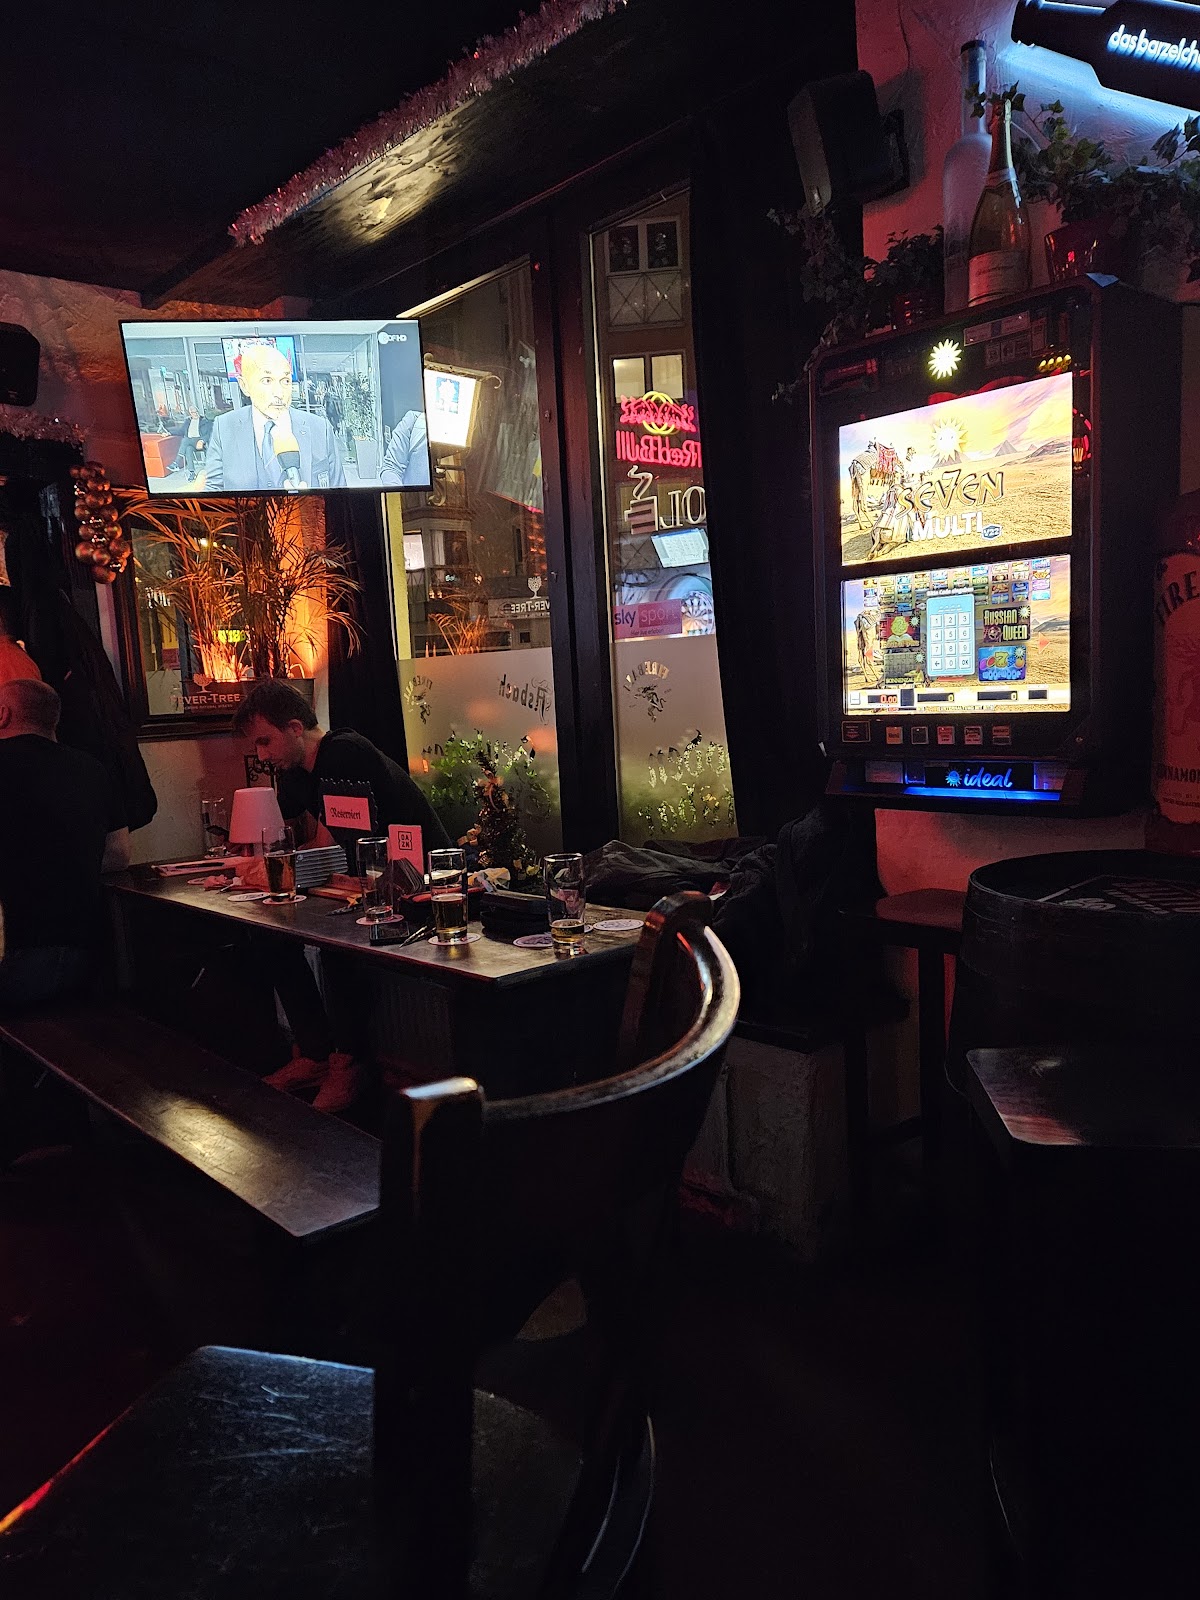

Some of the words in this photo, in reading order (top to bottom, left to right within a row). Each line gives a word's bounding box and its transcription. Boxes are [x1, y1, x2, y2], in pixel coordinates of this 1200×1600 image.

[895, 469, 1004, 520] SEVEN
[912, 510, 984, 541] MULTI
[614, 608, 636, 627] sky
[639, 606, 678, 625] sport
[984, 609, 1018, 625] RUSSIAN
[1003, 625, 1028, 640] QUEEN
[881, 693, 897, 702] 0.00
[964, 766, 1013, 788] ideal
